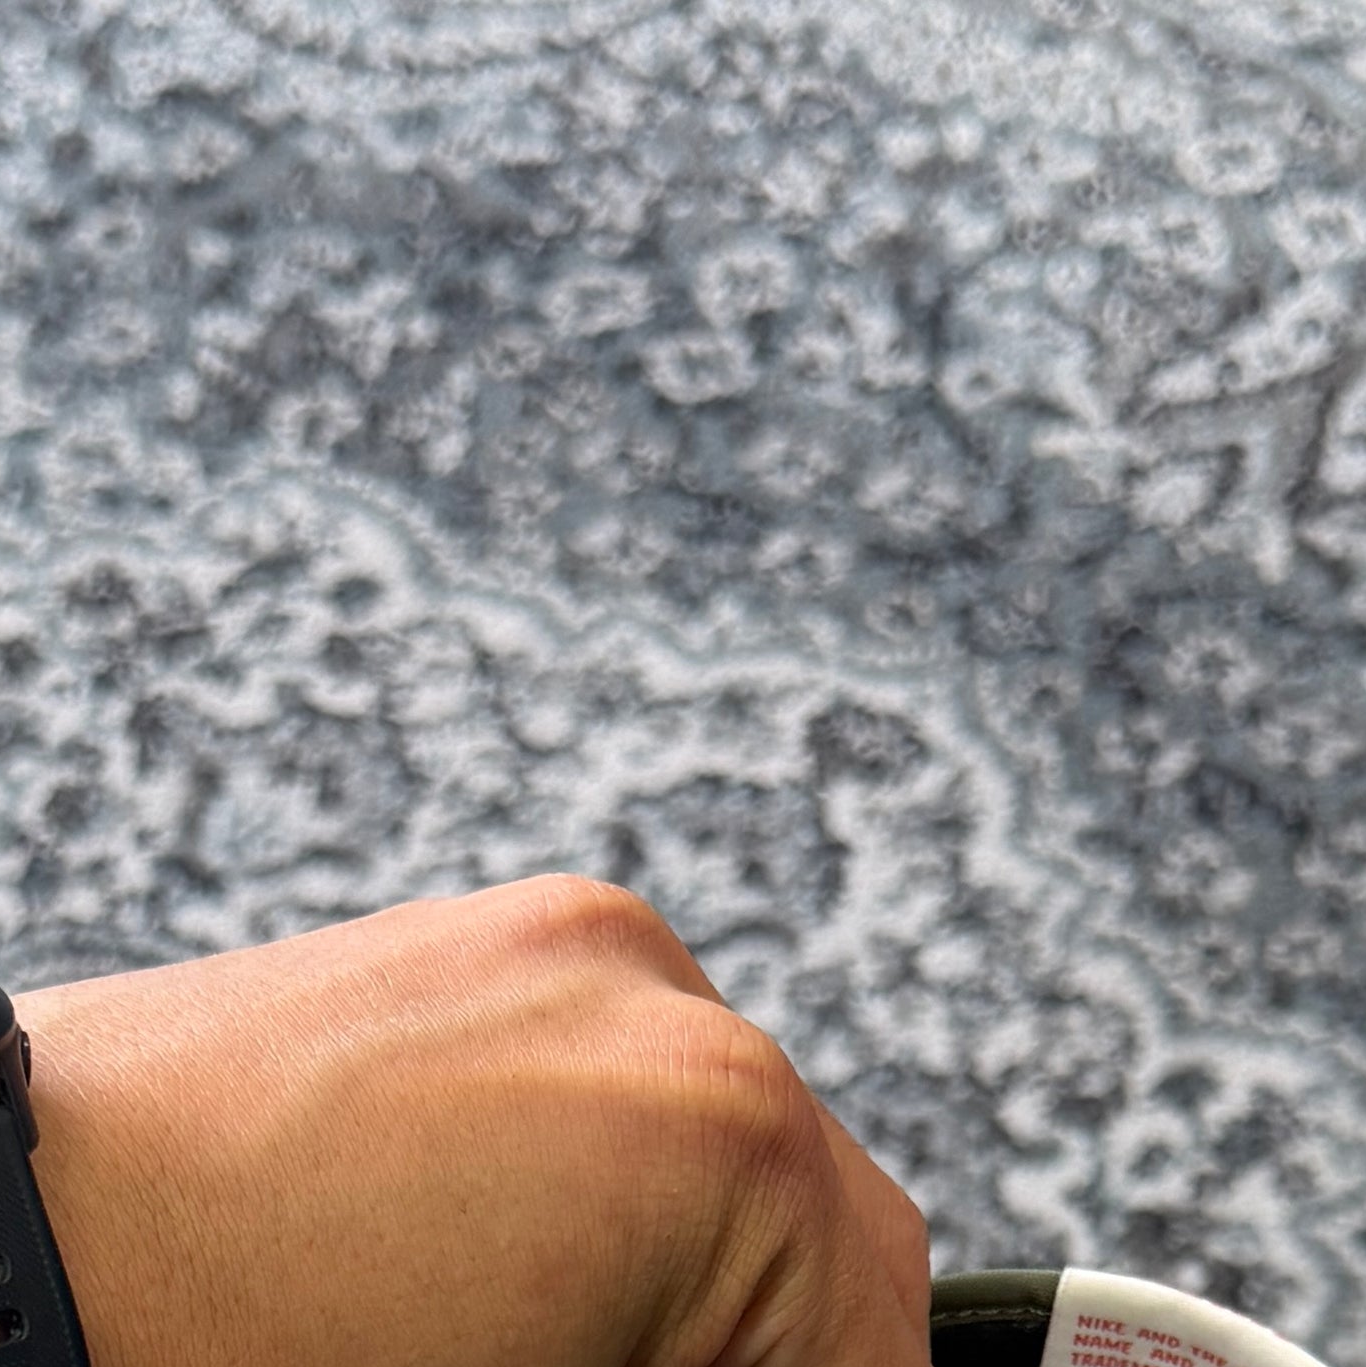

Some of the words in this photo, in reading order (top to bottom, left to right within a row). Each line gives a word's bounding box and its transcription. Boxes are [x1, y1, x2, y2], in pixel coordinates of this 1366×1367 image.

[1073, 1333, 1133, 1355] NAME
[1077, 1315, 1127, 1336] NIKE
[1137, 1328, 1181, 1349] AND
